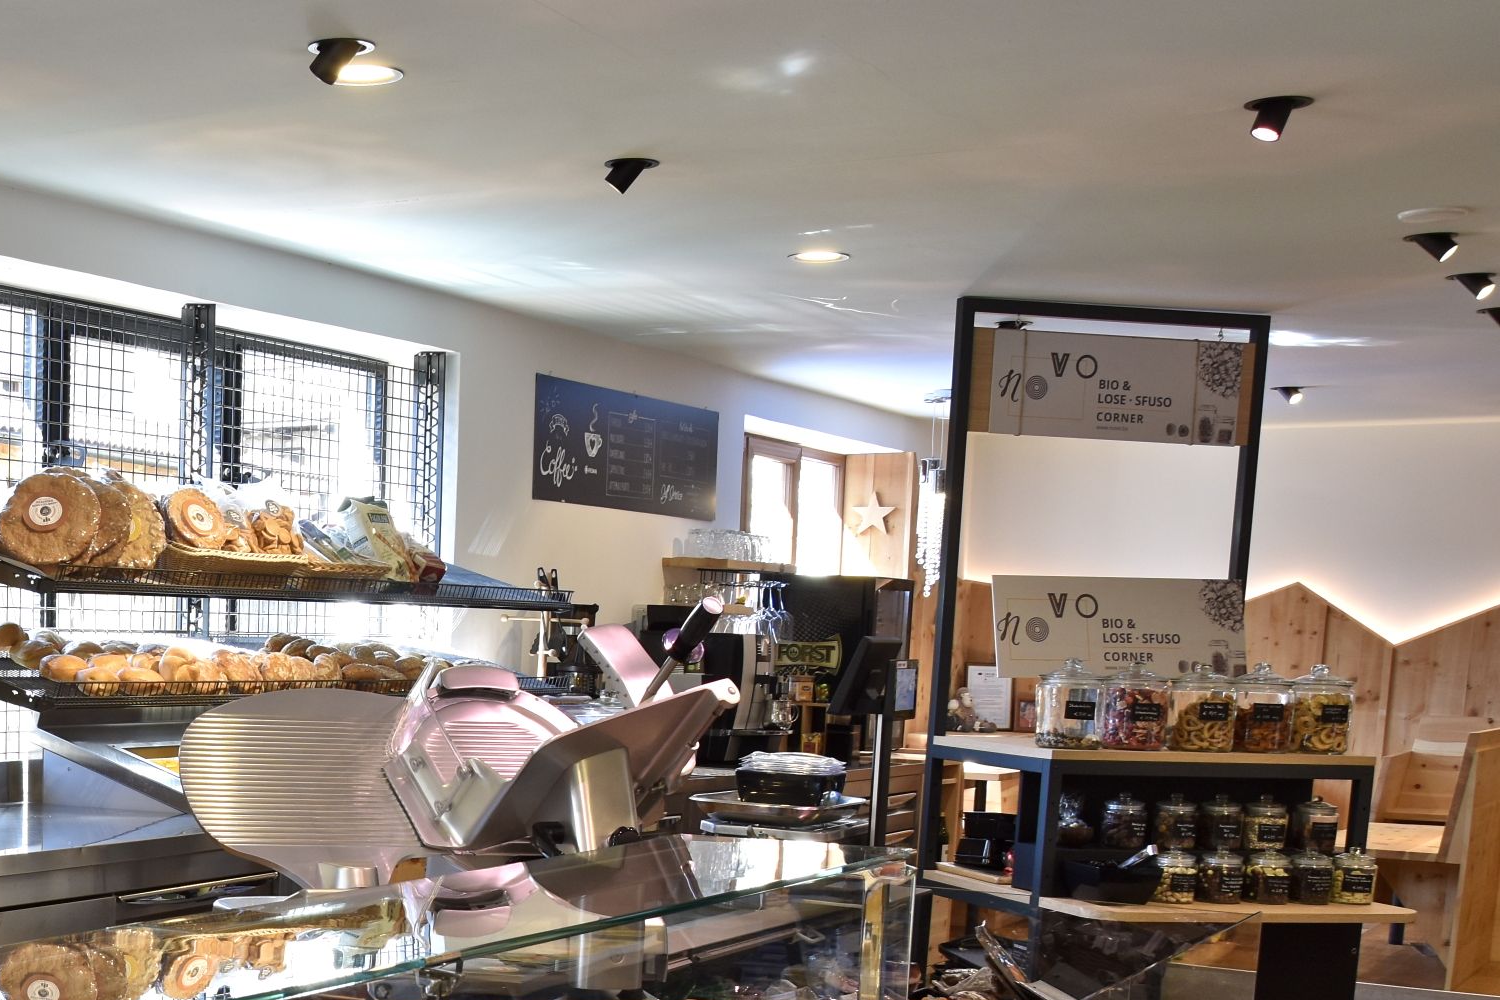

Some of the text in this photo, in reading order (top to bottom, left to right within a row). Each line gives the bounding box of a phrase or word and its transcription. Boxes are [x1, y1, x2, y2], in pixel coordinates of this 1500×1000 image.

[1099, 379, 1131, 391] BIO &
[1098, 393, 1172, 408] LOSE SFUSO
[1096, 411, 1144, 424] CORNER
[1102, 618, 1136, 629] BIO &
[1103, 632, 1181, 645] LOSE SFUSO
[777, 644, 835, 663] FORST
[1103, 651, 1154, 662] CORNER
